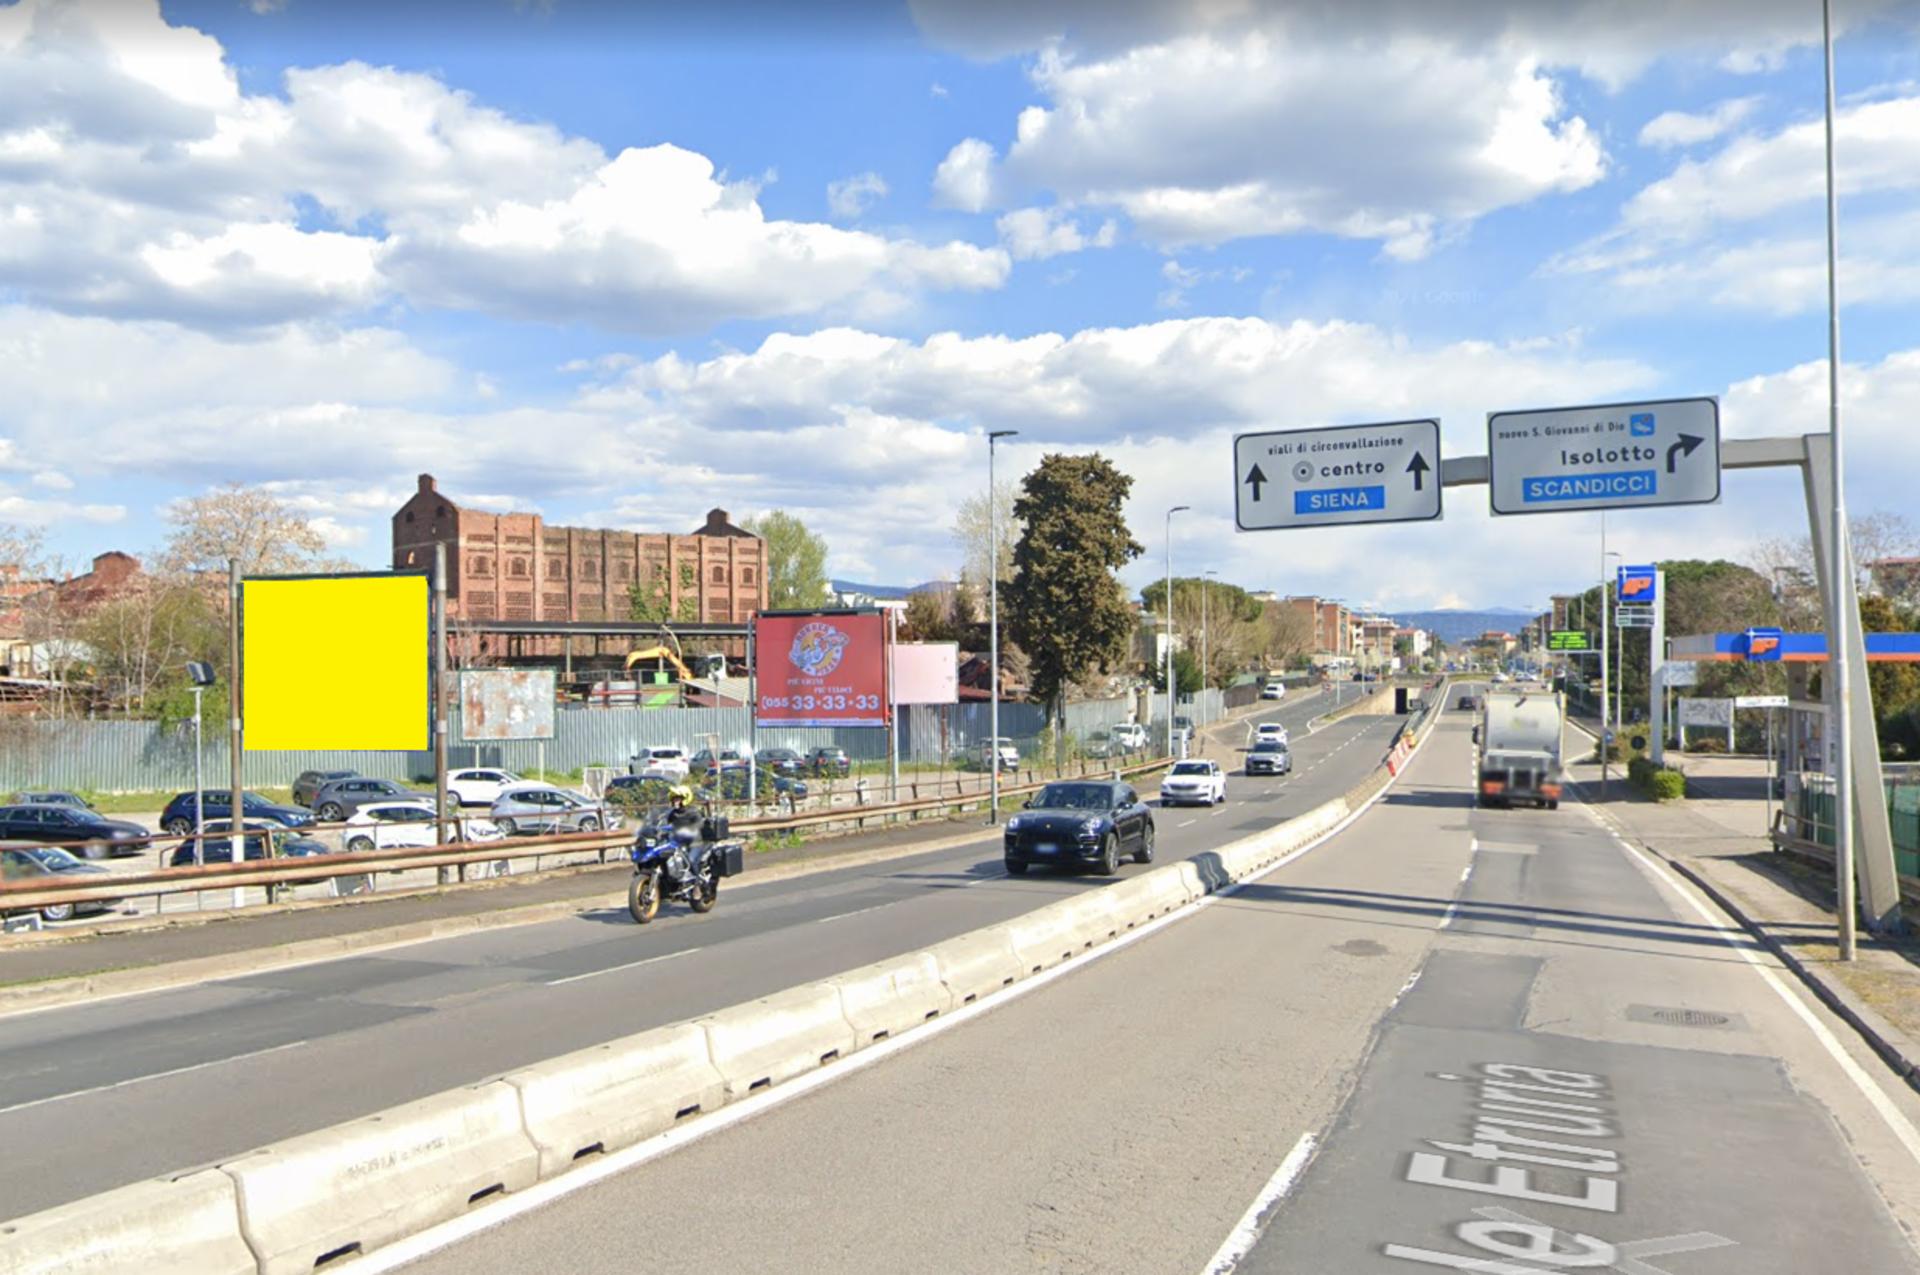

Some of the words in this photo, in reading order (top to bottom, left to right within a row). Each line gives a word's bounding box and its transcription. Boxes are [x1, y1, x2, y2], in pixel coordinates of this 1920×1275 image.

[1545, 424, 1590, 436] Giovanni
[1594, 422, 1604, 433] di
[1608, 420, 1626, 433] Dio
[1268, 444, 1292, 456] viali
[1297, 443, 1307, 453] di
[1311, 436, 1404, 453] circonvallazione
[1561, 445, 1656, 465] Isolotto
[1320, 461, 1385, 478] centro
[1530, 475, 1650, 497] SCANDICCI
[1310, 491, 1369, 509] SIENA
